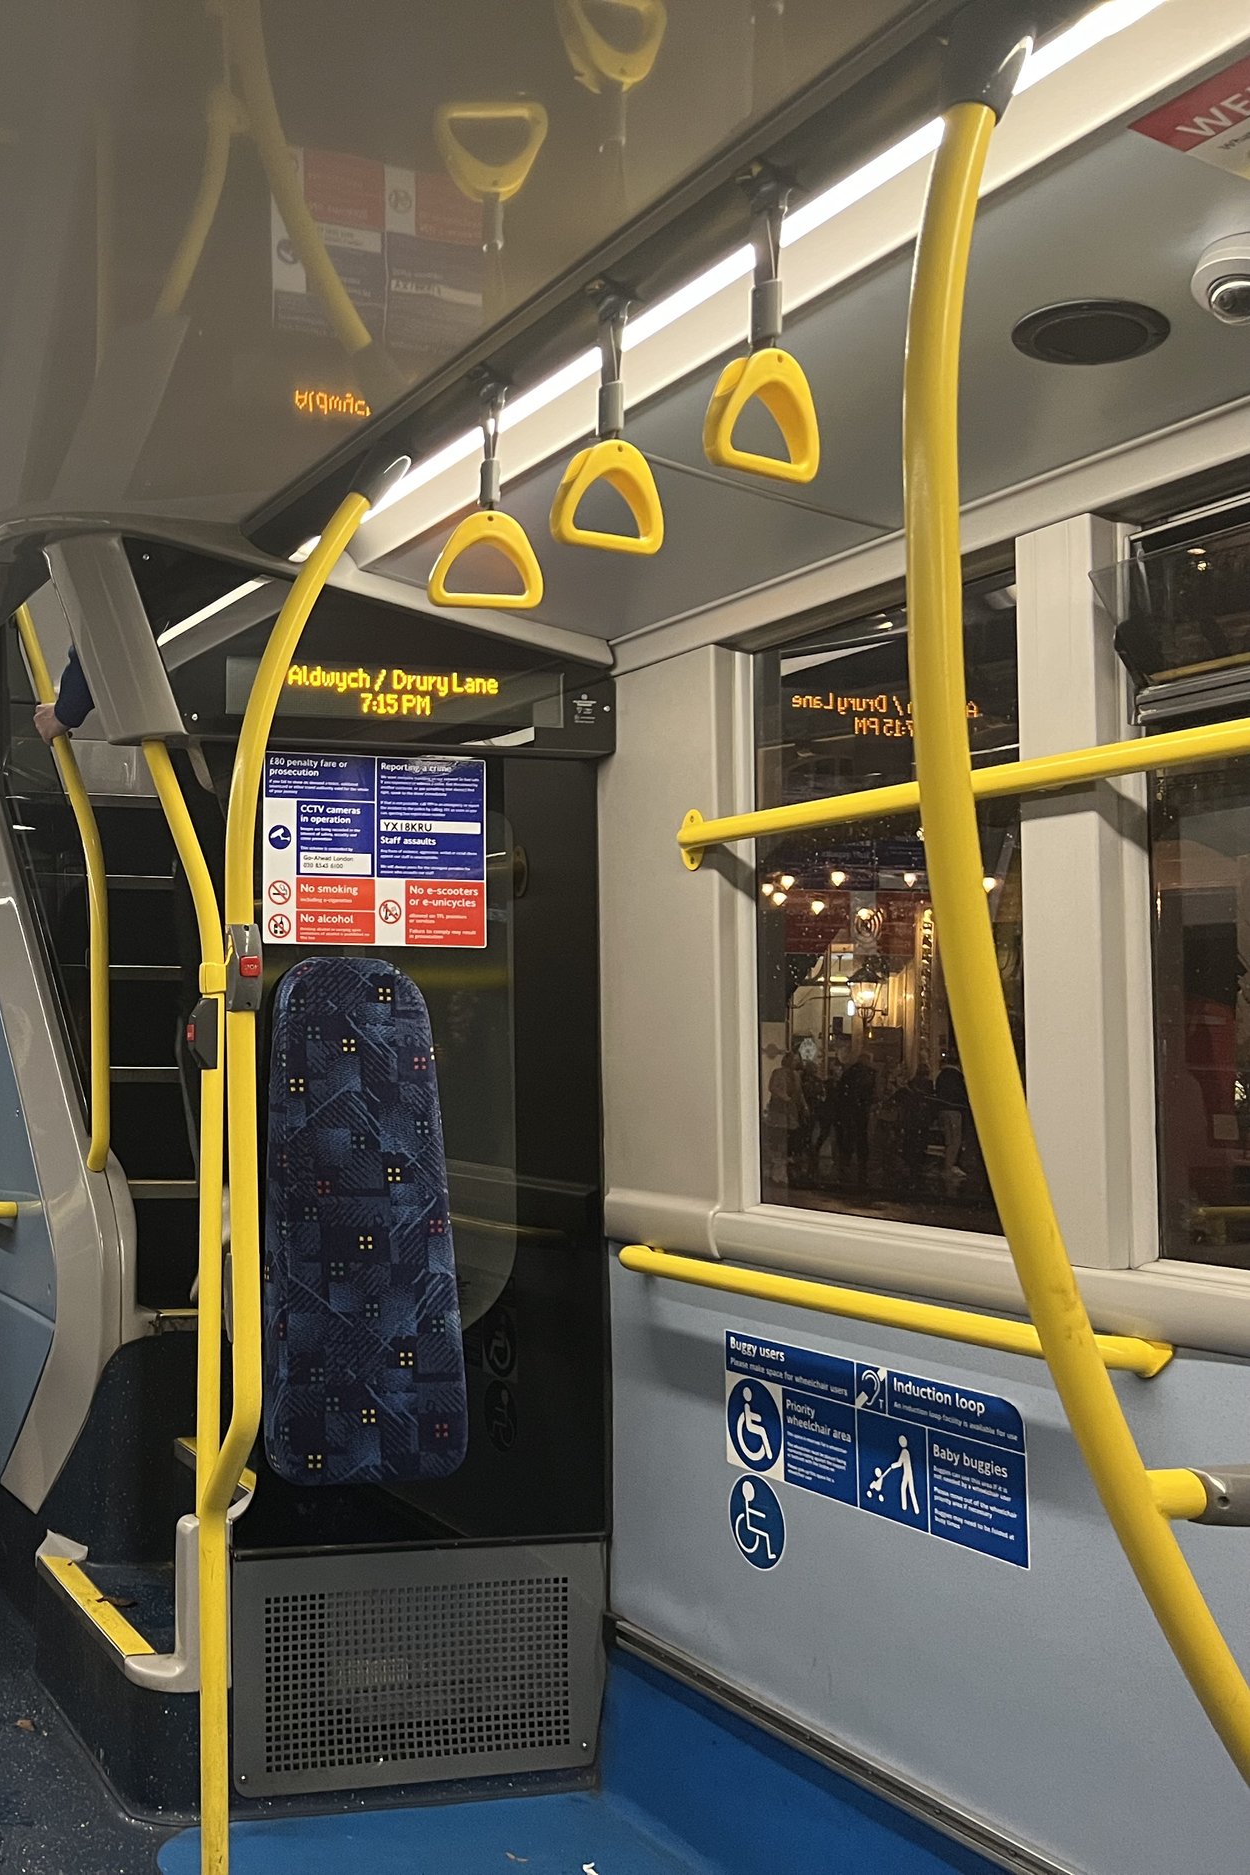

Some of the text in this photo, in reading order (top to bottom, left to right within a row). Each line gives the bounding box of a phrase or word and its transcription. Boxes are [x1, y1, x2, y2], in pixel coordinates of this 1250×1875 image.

[1175, 87, 1250, 136] WE
[288, 665, 499, 697] Aldwych / Drury Lane
[360, 693, 432, 716] 7:15 PM
[270, 757, 285, 766] £80
[287, 759, 318, 768] penalty
[320, 759, 336, 768] fare
[381, 763, 420, 773] Reporting
[429, 765, 451, 773] crime
[270, 768, 319, 776] prosecution
[300, 805, 361, 815] CCTV cameras
[300, 814, 351, 824] in operation
[380, 836, 401, 844] Staff
[300, 884, 358, 895] No smoking
[409, 885, 478, 896] No e-scooters
[422, 899, 476, 908] e-unicycles
[300, 914, 354, 924] No alcohol
[730, 1336, 785, 1362] Buggy users
[730, 1357, 848, 1396] Please make space for wheelchair users
[894, 1377, 986, 1416] Induction loop
[786, 1399, 815, 1419] Priority
[786, 1415, 830, 1436] wheelchair
[833, 1429, 852, 1443] area
[933, 1444, 1008, 1478] Baby buggies
